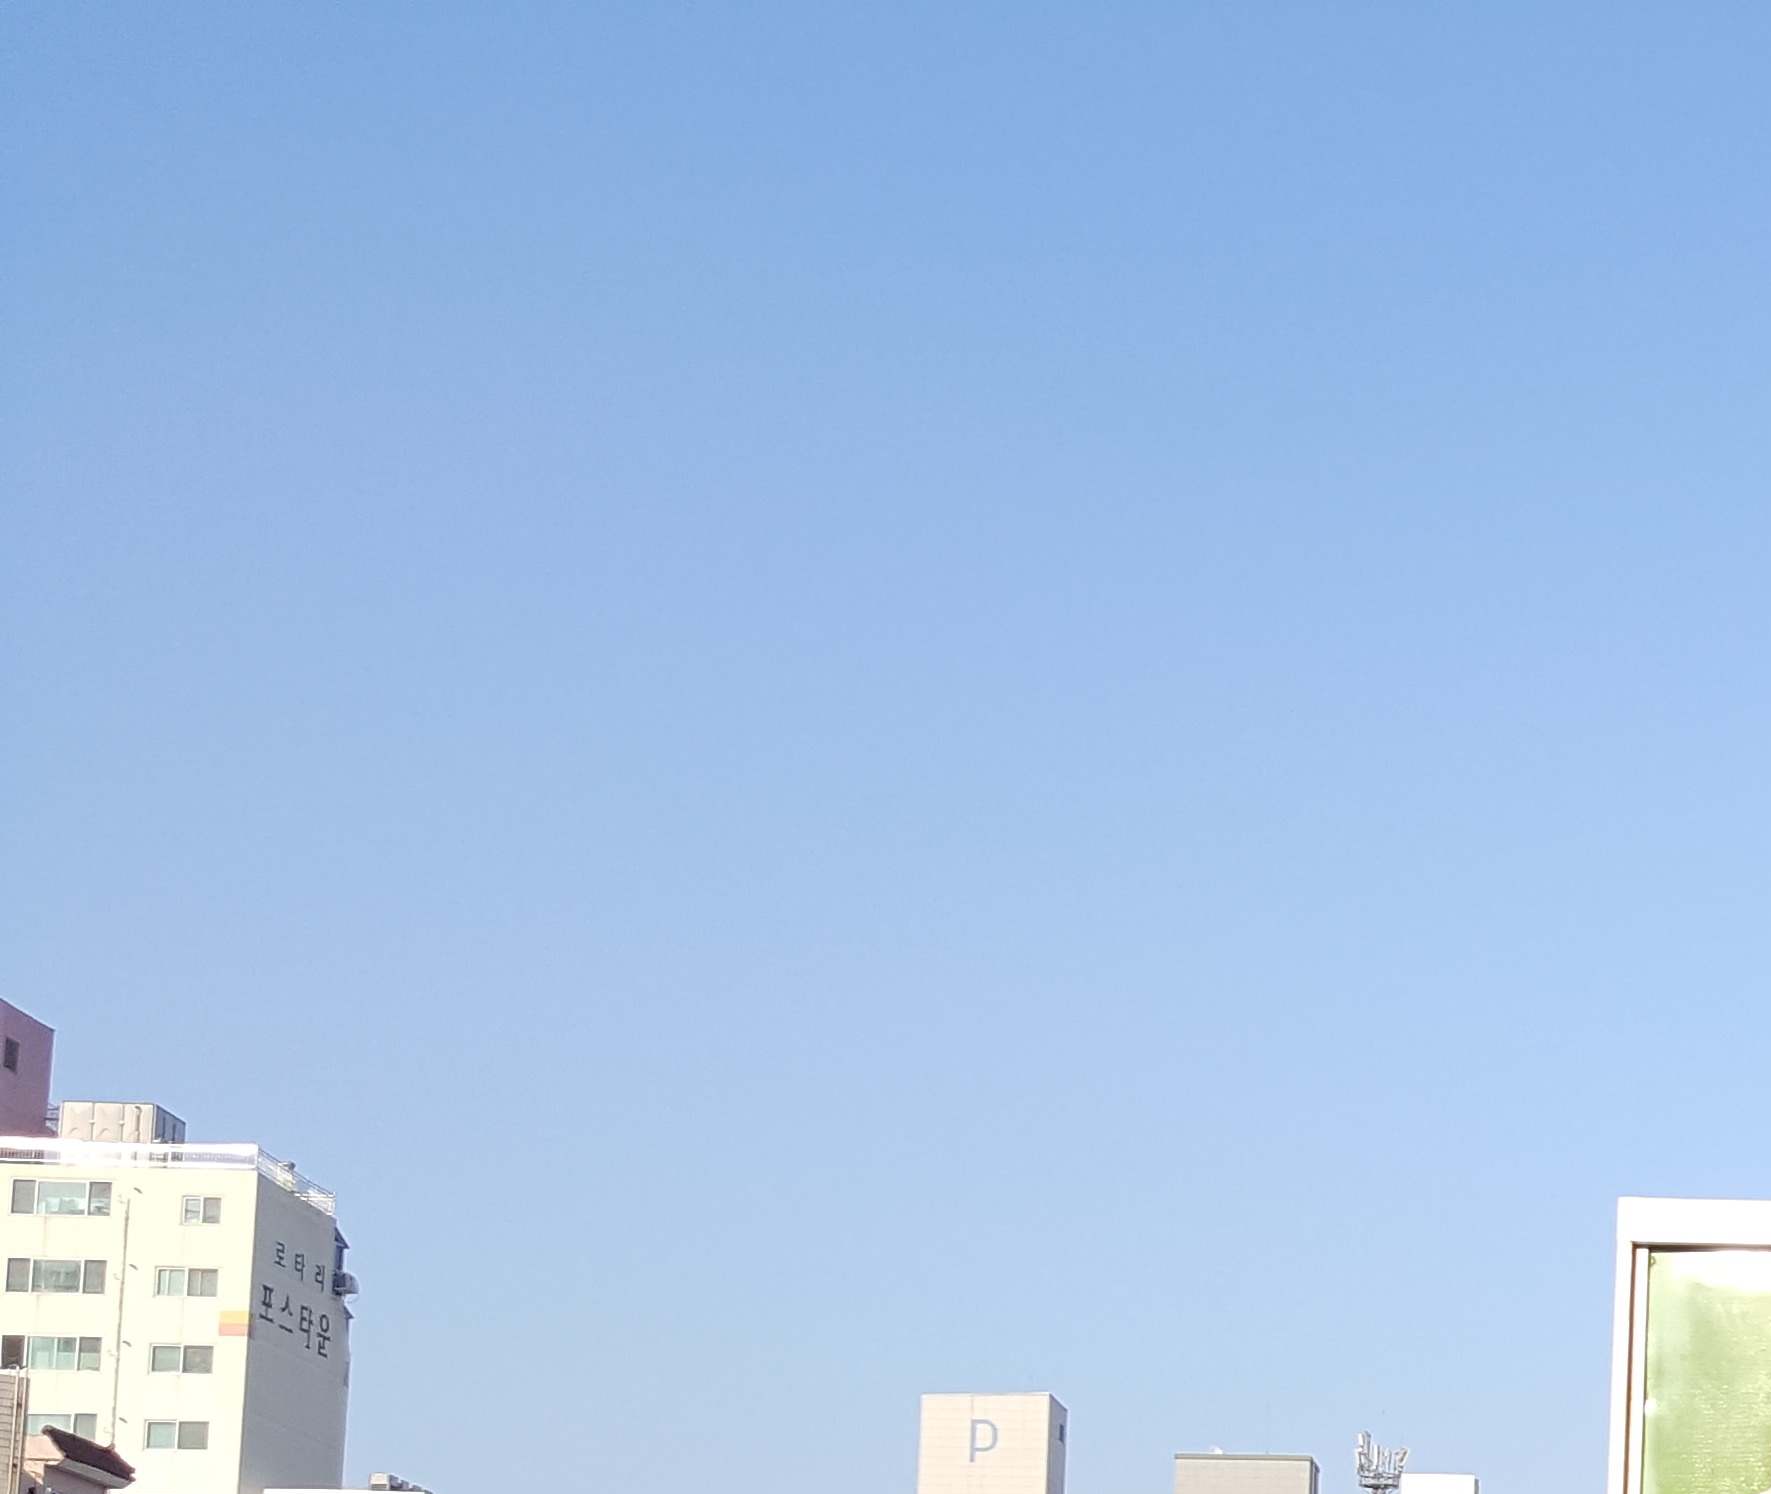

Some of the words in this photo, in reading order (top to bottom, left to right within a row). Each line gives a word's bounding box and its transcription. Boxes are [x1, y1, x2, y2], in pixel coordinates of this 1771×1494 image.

[274, 1241, 325, 1293] 로타리
[259, 1283, 332, 1359] 포스타운
[969, 1418, 998, 1463] P
